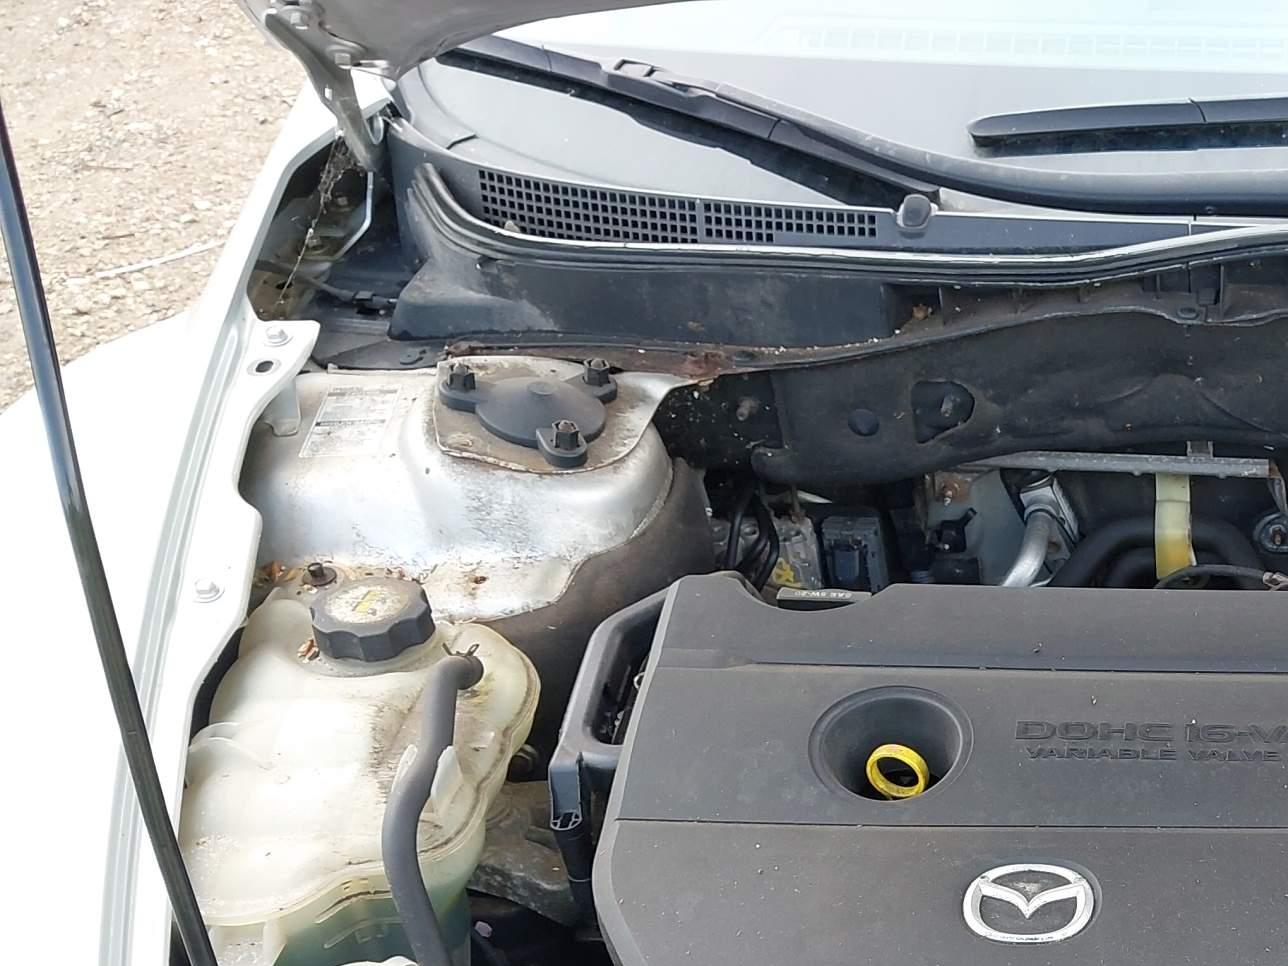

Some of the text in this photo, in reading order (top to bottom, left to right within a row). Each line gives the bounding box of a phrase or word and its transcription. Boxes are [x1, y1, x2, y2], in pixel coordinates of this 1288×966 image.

[1015, 720, 1176, 741] DOHC
[1025, 747, 1177, 761] VARIABLE
[1188, 749, 1282, 762] VALVE
